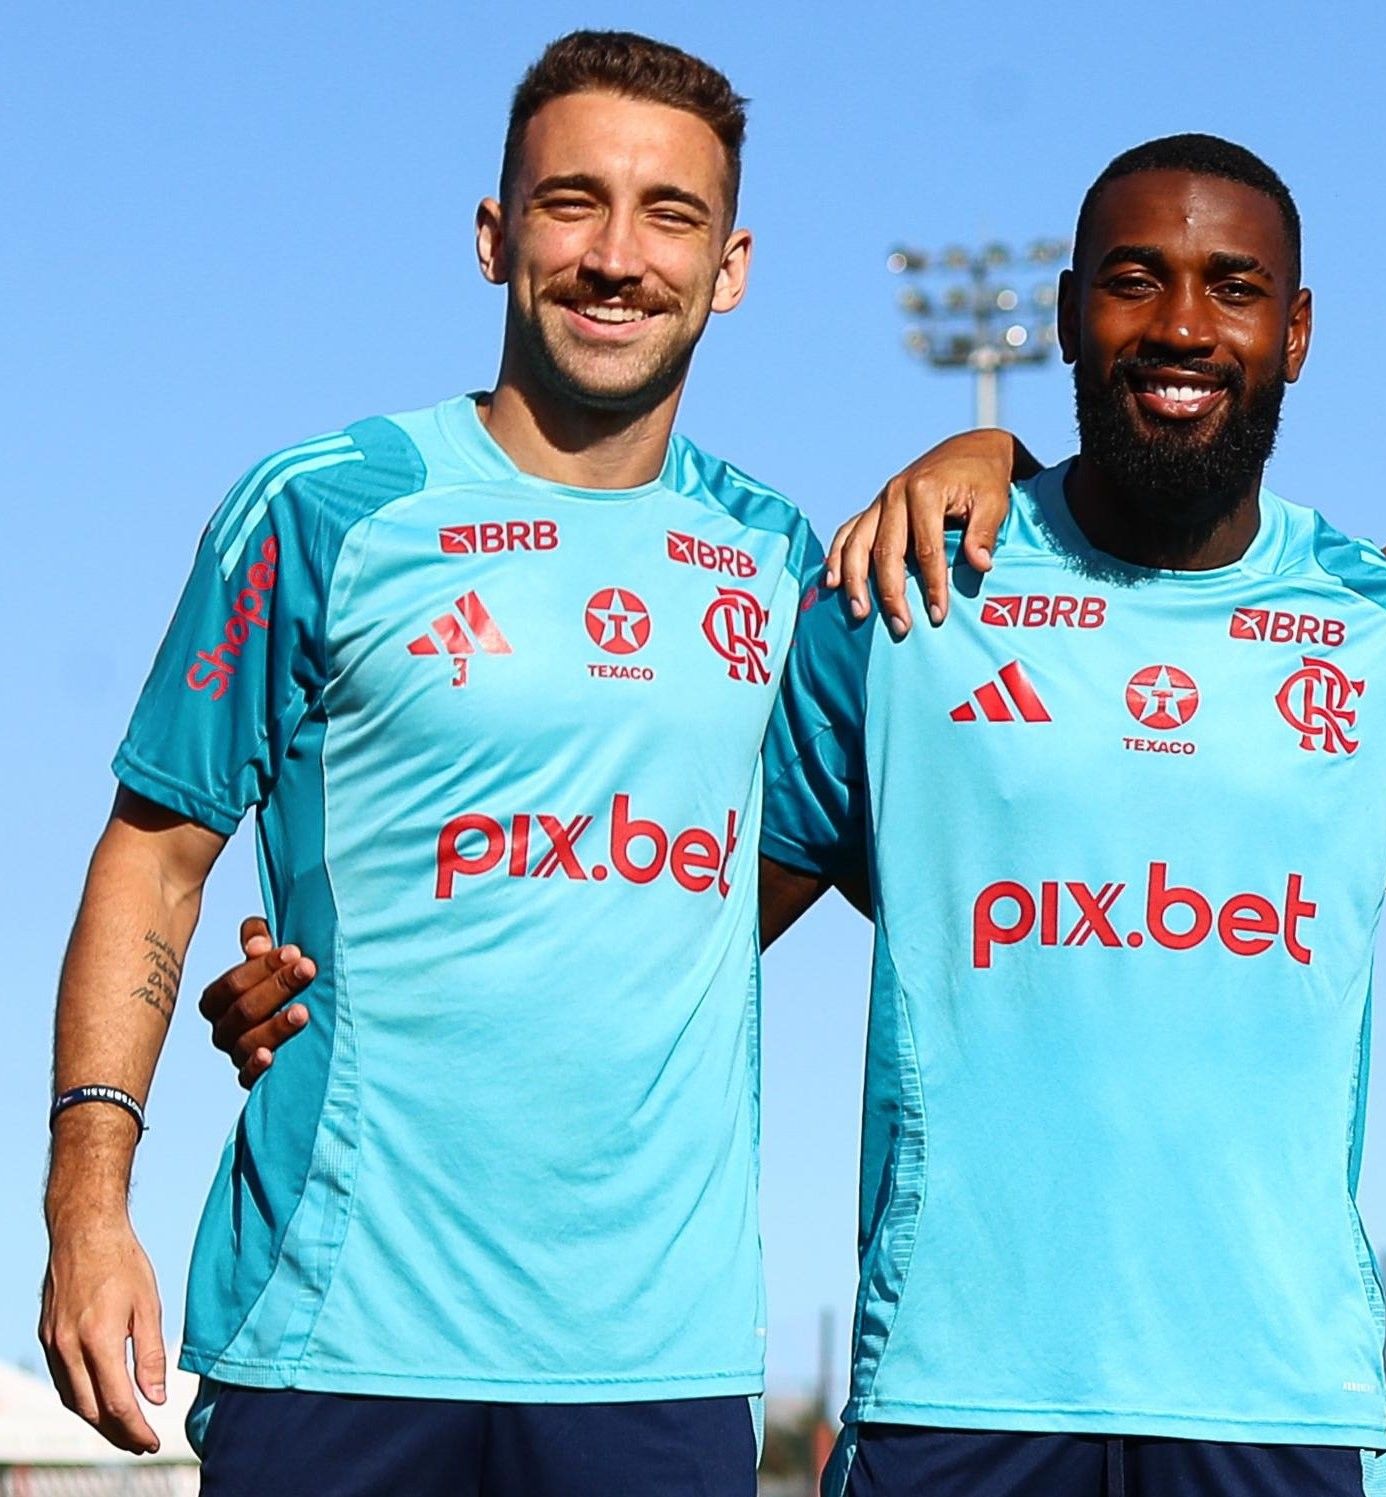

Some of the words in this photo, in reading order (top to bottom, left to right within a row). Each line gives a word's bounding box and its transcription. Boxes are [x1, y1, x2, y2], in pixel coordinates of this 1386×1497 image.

[481, 519, 559, 554] BRB
[698, 544, 758, 580] BRB
[186, 535, 279, 700] Shopee
[1027, 594, 1108, 630] BRB
[1270, 611, 1347, 648] BRB
[587, 664, 654, 682] TEXACO
[1122, 736, 1196, 755] TEXACO
[972, 860, 1319, 970] pix.bet
